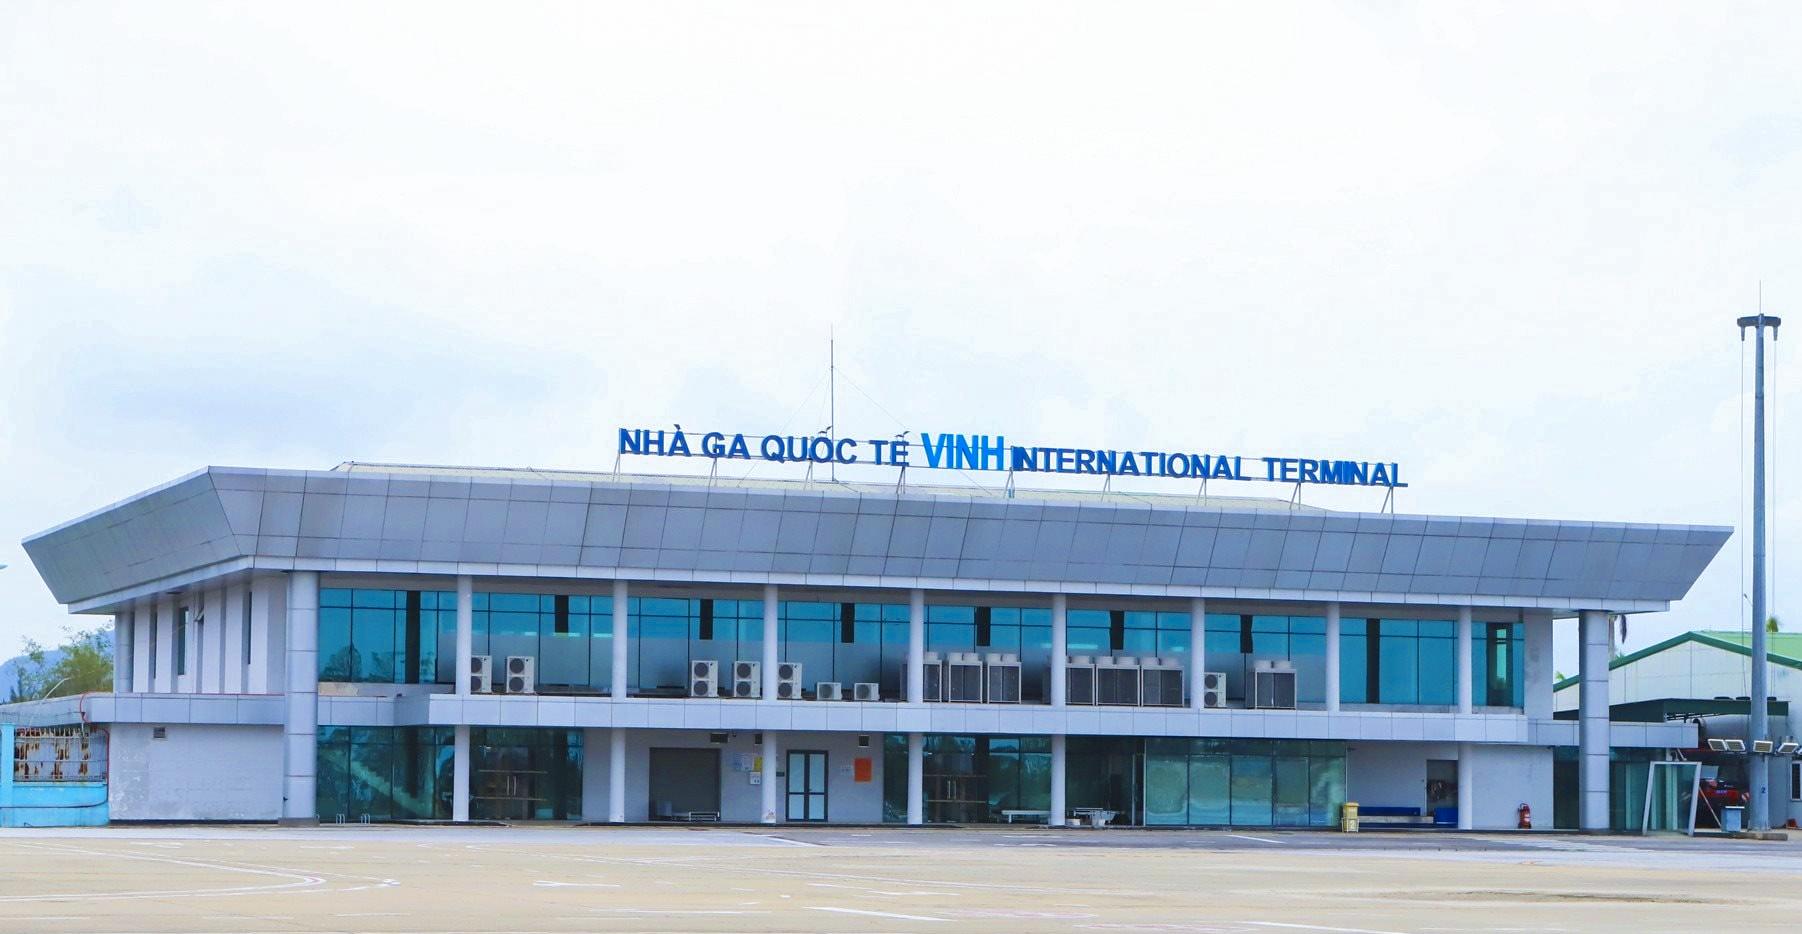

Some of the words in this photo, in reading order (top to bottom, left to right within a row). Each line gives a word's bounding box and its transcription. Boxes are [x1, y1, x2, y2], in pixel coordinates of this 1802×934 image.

[620, 424, 692, 457] NHÀ
[702, 432, 751, 459] GA
[760, 425, 857, 464] QUỐC
[869, 430, 910, 467] TẾ
[921, 433, 1004, 471] VINH
[1011, 446, 1252, 481] INTERNATIONAL
[1262, 457, 1408, 487] TERMINAL
